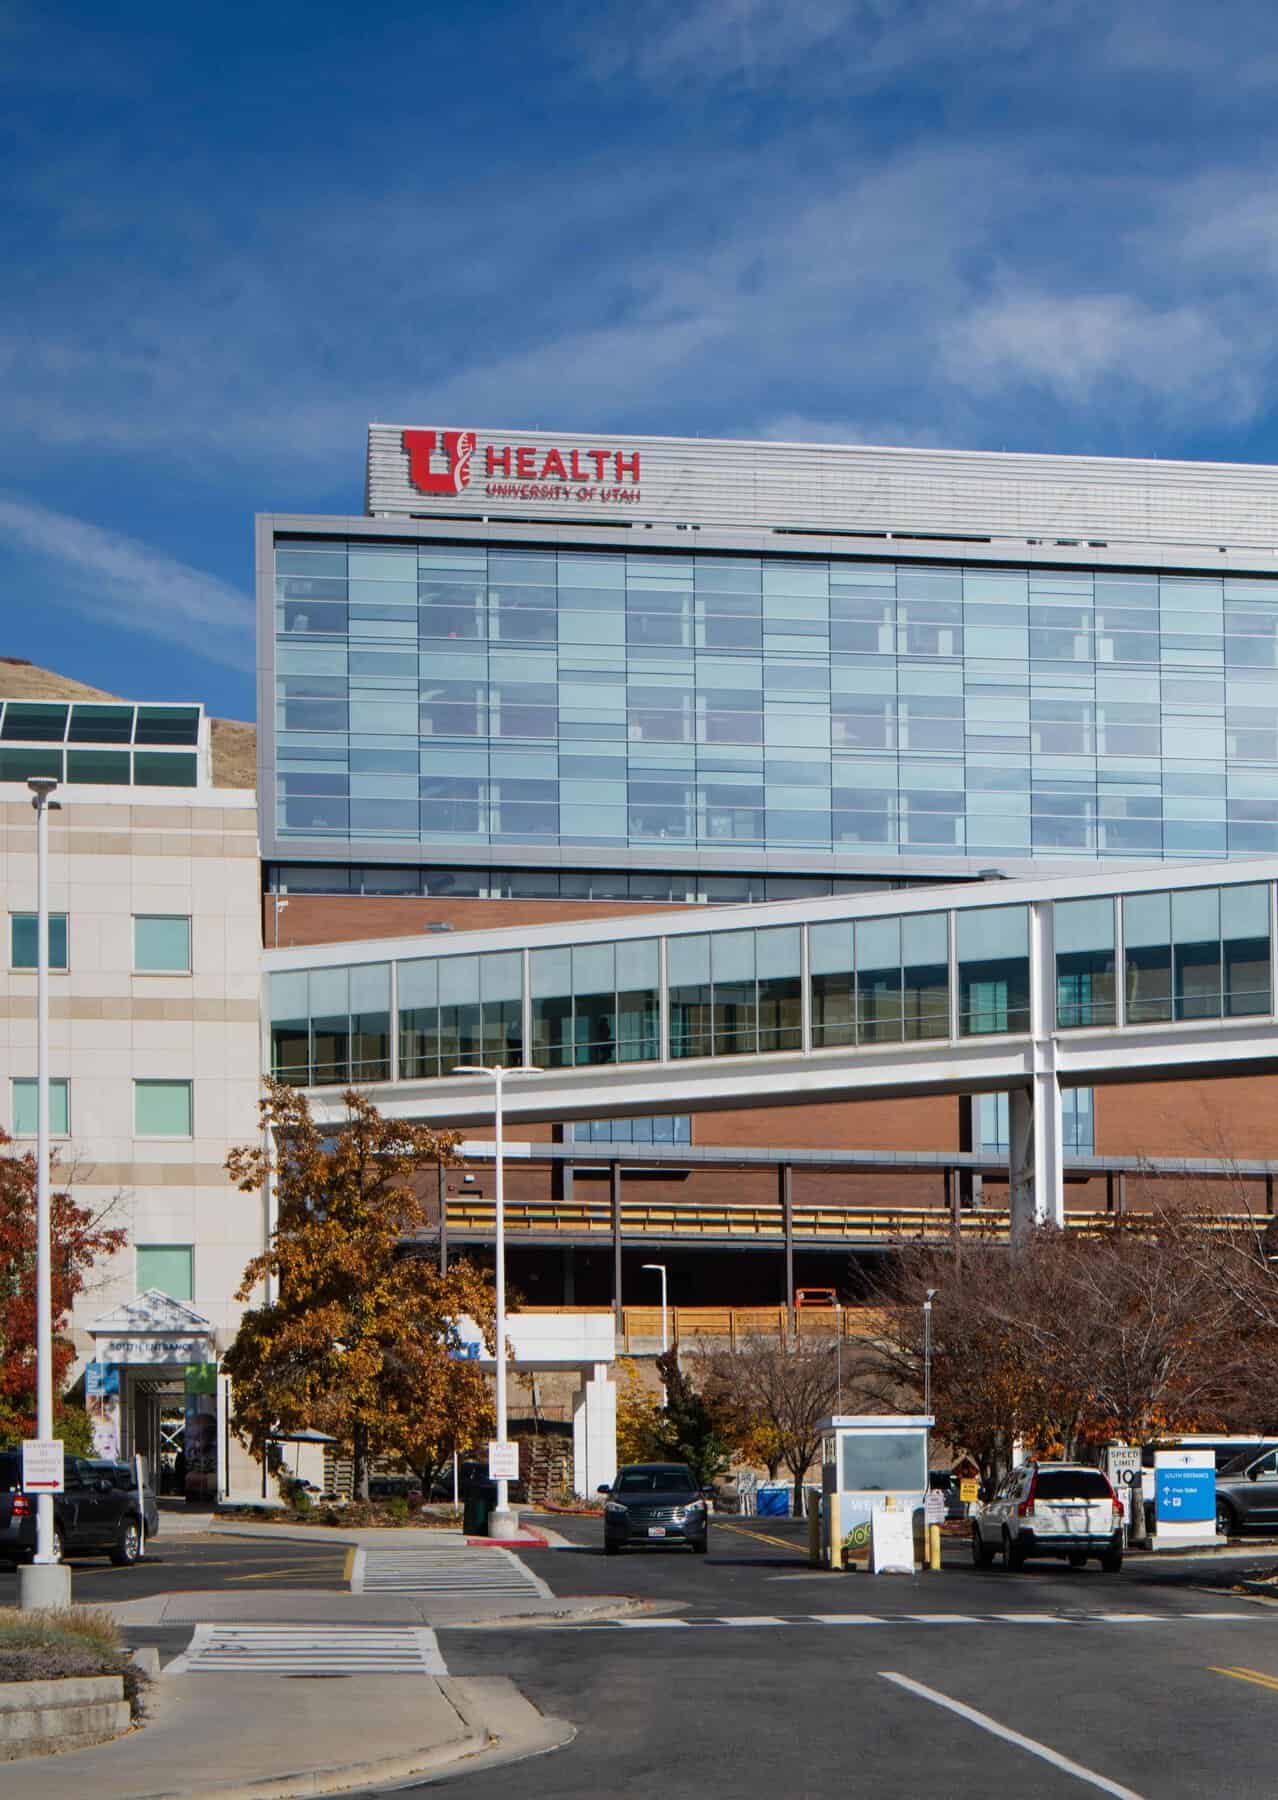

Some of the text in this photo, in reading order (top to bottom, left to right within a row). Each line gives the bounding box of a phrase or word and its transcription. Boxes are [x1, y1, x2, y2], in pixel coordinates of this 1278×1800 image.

[486, 446, 640, 482] HEALTH
[486, 483, 641, 504] UNIVERSITY OF UTAH
[110, 1343, 192, 1352] SOUTH ENTRANCE
[1116, 1469, 1134, 1485] 10
